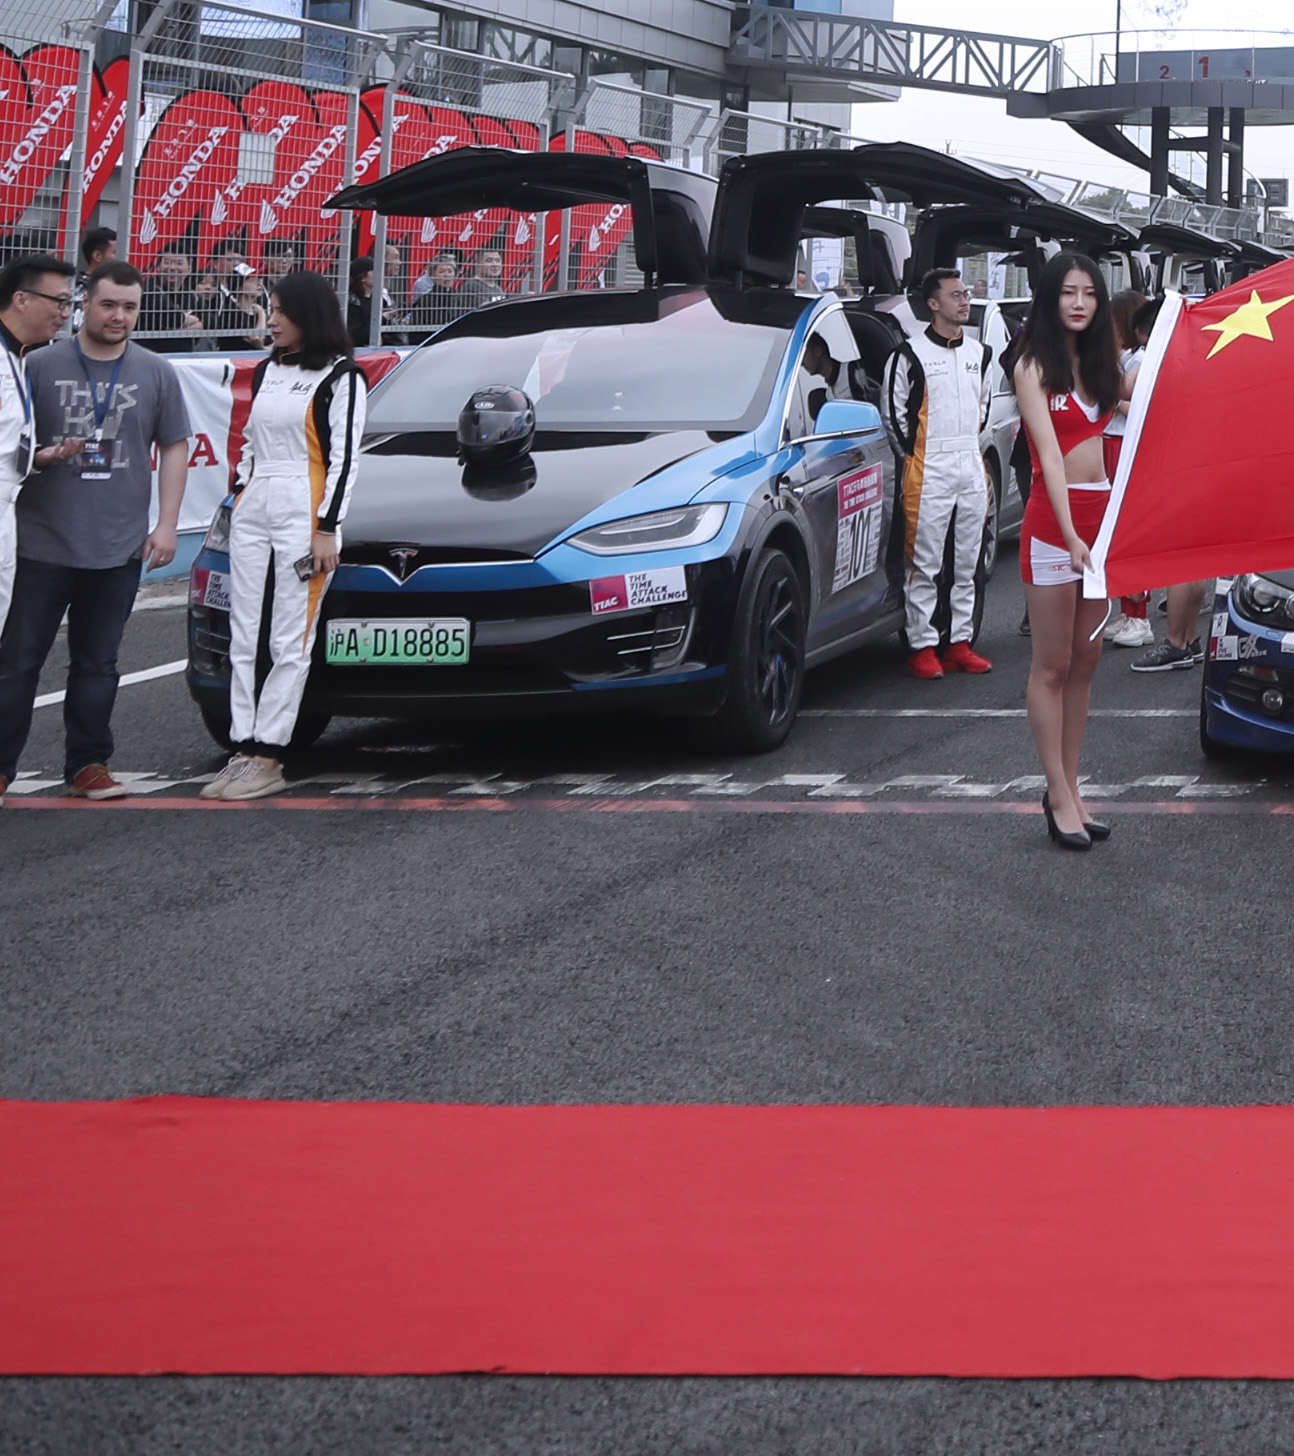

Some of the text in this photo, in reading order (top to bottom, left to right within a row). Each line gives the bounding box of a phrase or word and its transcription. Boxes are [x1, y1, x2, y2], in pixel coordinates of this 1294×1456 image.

[1159, 65, 1170, 79] 2
[1198, 56, 1210, 78] 1
[0, 85, 78, 185] HONDA
[153, 125, 229, 217] HONDA
[273, 124, 347, 210] HONDA
[628, 573, 647, 584] THE
[630, 580, 653, 591] TIME
[630, 591, 688, 606] CHALLENGE
[631, 585, 669, 598] ATTACK
[593, 596, 620, 612] TTAC
